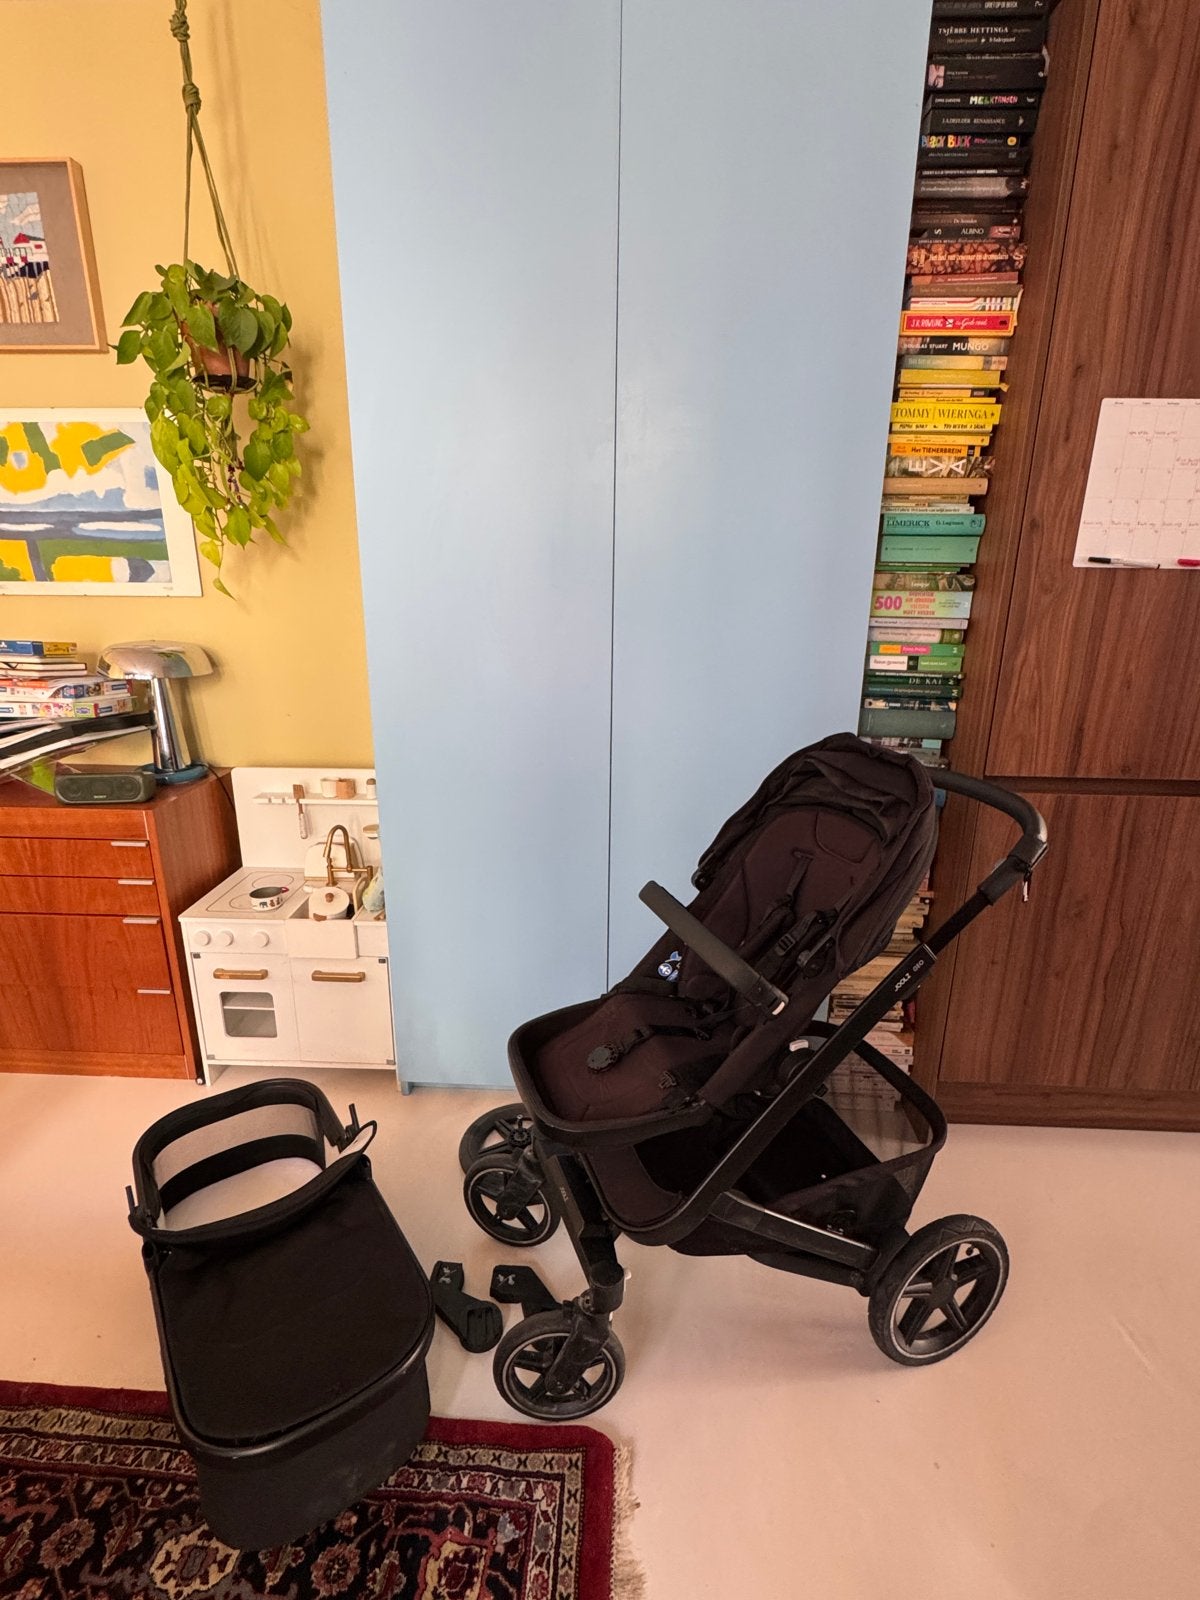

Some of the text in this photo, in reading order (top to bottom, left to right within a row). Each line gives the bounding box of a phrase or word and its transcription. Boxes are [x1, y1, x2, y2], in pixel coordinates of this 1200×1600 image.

[970, 26, 1009, 34] HETTINGA
[952, 342, 989, 351] MUNGO
[895, 407, 987, 419] TOMMY WIERINGA
[874, 595, 902, 611] 500
